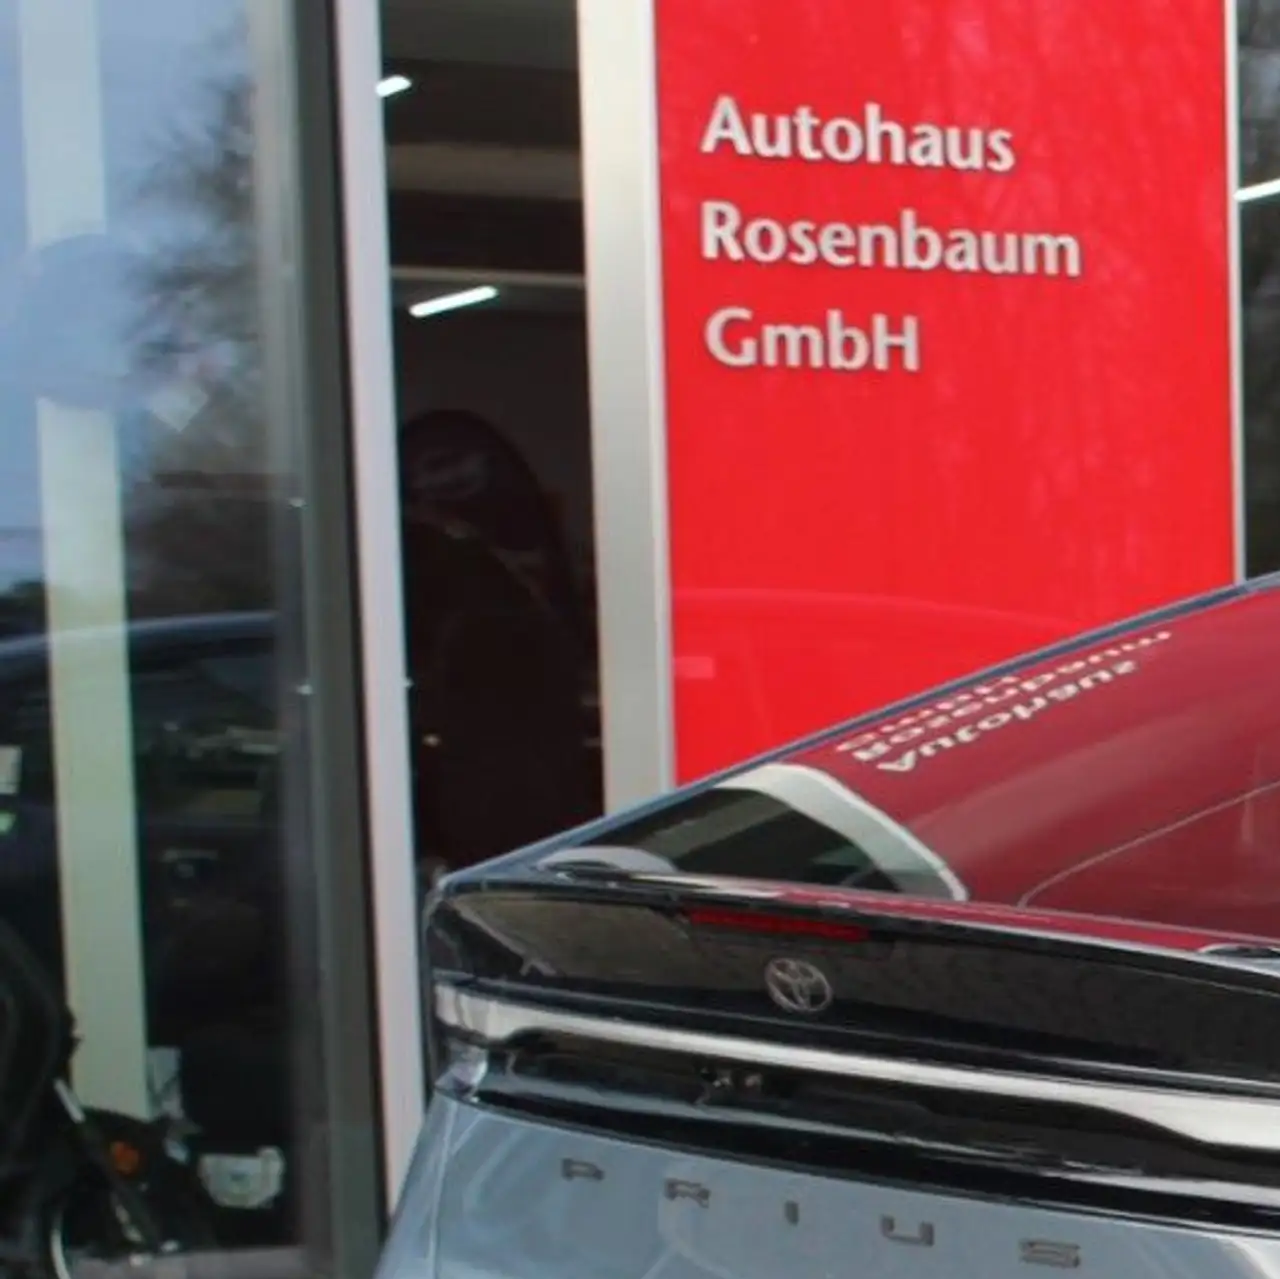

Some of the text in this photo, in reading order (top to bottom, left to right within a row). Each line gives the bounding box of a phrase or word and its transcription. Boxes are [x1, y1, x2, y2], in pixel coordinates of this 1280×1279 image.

[701, 95, 1016, 172] Autohaus
[701, 200, 1082, 277] Rosenbaum
[704, 305, 921, 371] GmbH
[561, 1157, 1082, 1270] PRIUS
